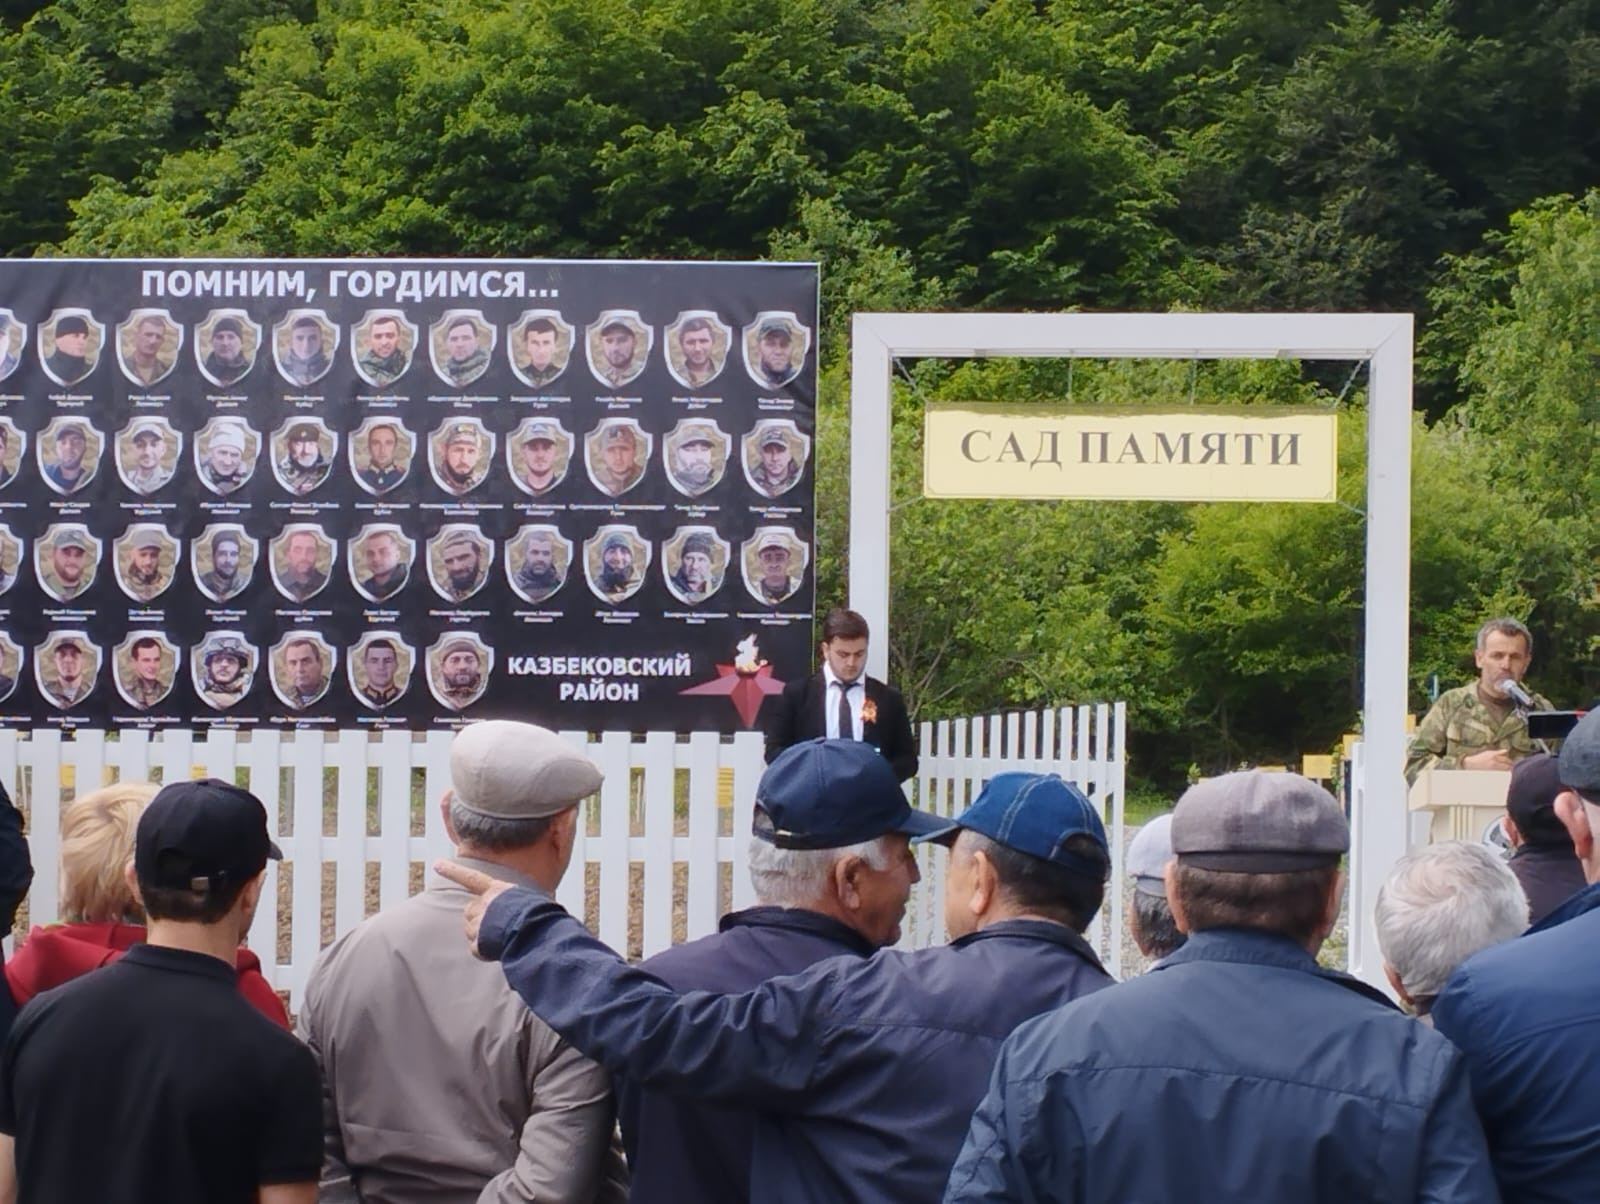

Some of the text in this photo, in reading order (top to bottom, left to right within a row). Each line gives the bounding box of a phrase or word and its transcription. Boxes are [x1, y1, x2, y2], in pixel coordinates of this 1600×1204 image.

[141, 270, 560, 303] ПОМНИМ, ГОРДИМСЯ...
[961, 430, 1302, 472] САД ПАМЯТИ
[508, 653, 692, 677] КАЗБЕКОВСКИЙ
[559, 678, 640, 701] РАЙОН
